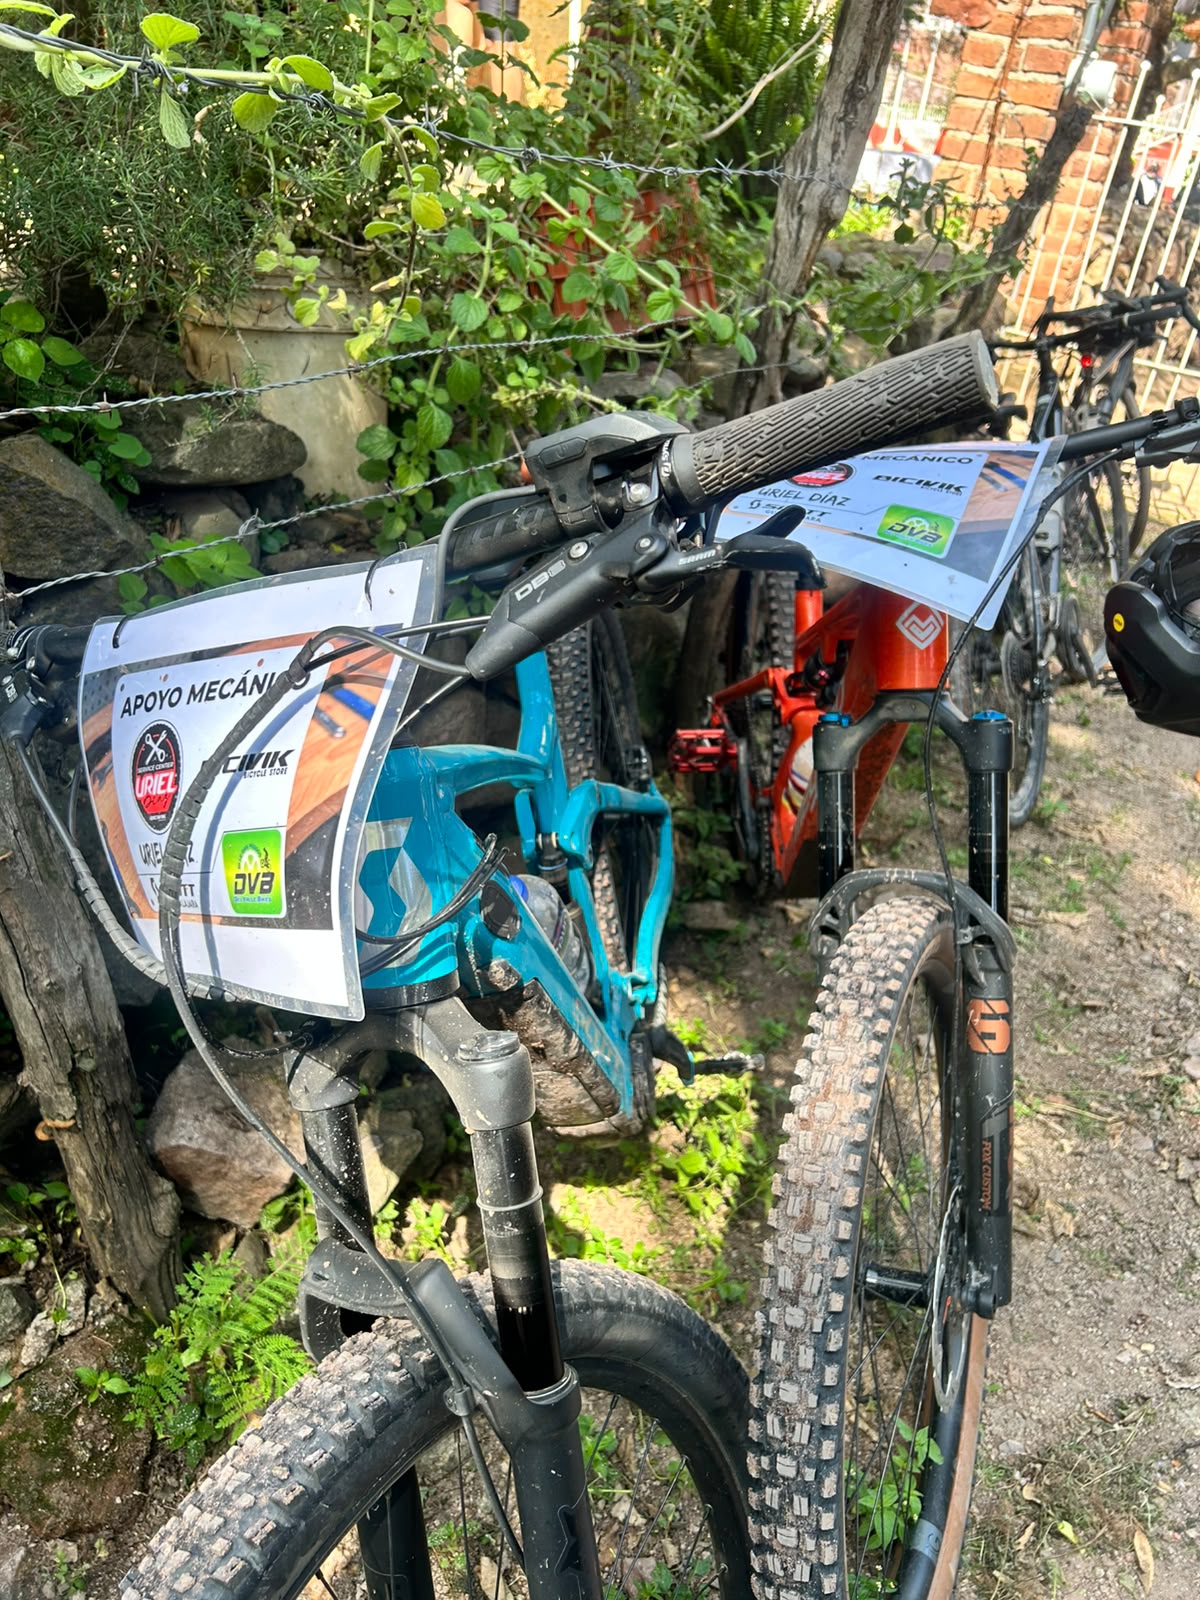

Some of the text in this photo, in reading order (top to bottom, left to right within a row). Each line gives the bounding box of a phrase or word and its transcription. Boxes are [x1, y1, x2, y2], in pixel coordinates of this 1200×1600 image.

[872, 474, 968, 492] BICIVIK
[758, 487, 852, 506] URIEL DÍAZ
[762, 503, 832, 517] STT
[887, 522, 944, 543] DVB
[120, 686, 183, 719] APOYO
[244, 767, 288, 779] BICYCLE STORE
[136, 772, 178, 799] URIEL
[234, 871, 275, 896] DVB
[981, 1140, 993, 1211] FOX CUSTOM
